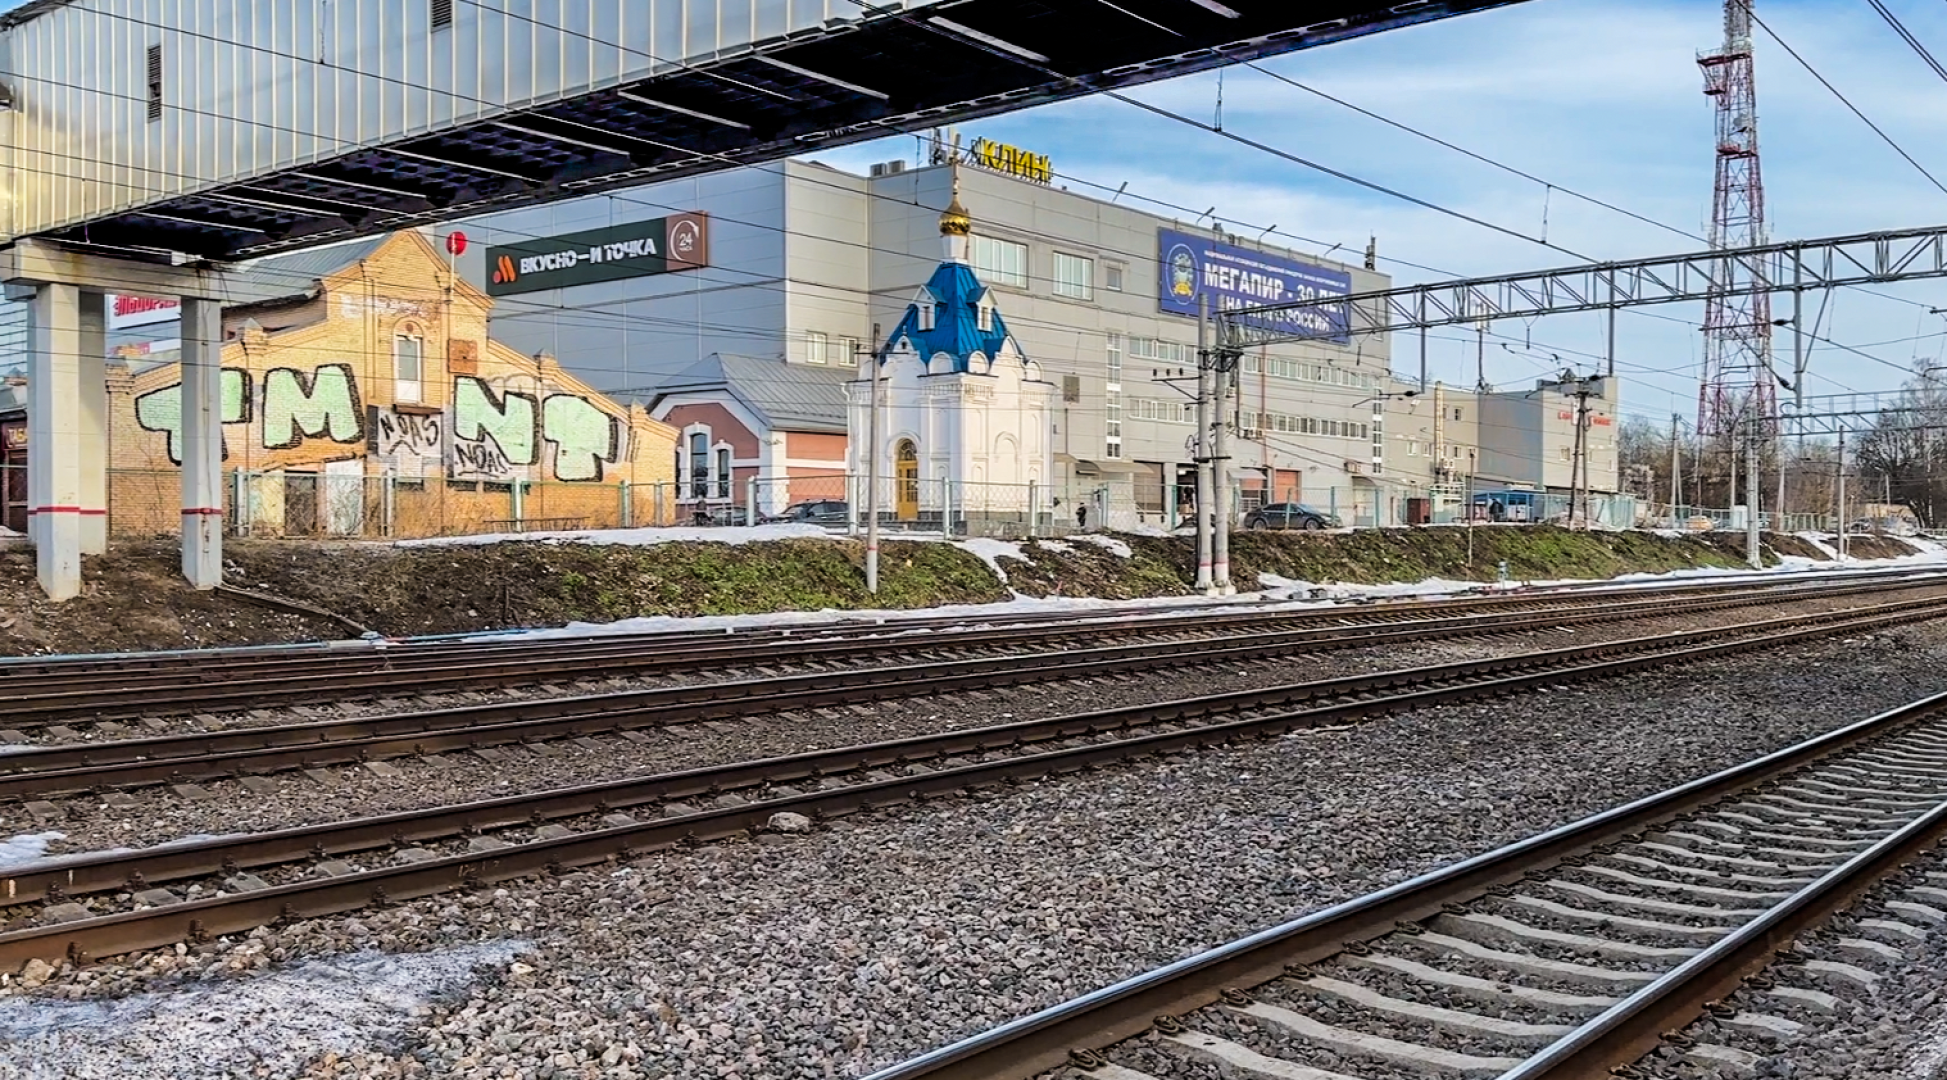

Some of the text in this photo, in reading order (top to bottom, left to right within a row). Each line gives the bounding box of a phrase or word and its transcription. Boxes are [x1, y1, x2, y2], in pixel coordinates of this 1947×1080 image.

[982, 139, 1049, 182] КЛИН
[603, 238, 657, 262] ТОЧКА
[679, 232, 693, 246] 24
[1204, 262, 1284, 301] МЕГАПИР
